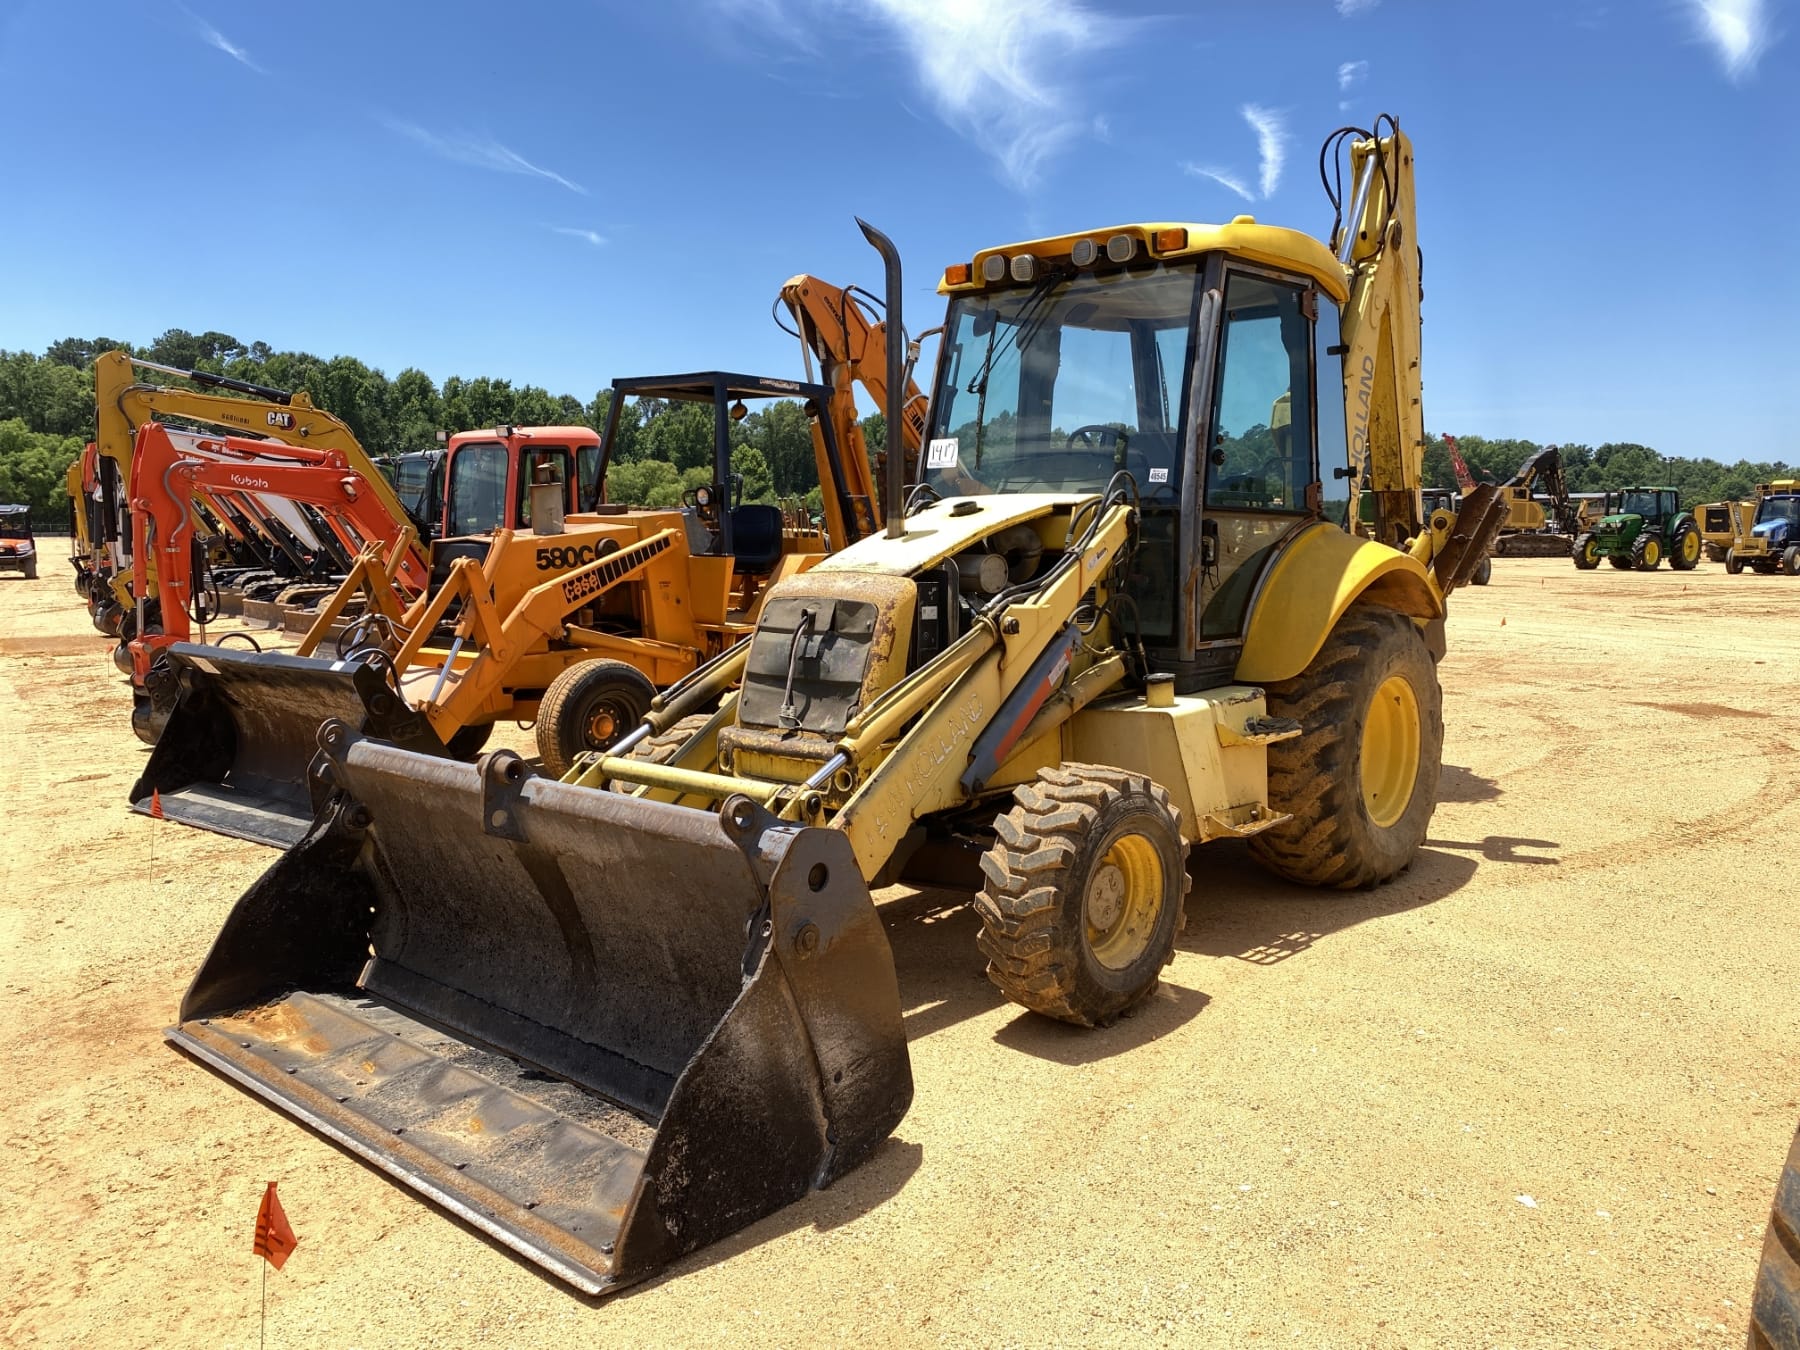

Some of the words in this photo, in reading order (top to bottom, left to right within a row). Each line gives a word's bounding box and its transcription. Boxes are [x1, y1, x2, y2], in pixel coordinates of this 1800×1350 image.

[267, 412, 289, 426] CAT
[932, 443, 956, 461] 1417
[230, 473, 269, 488] Kubota
[536, 545, 595, 570] 580C
